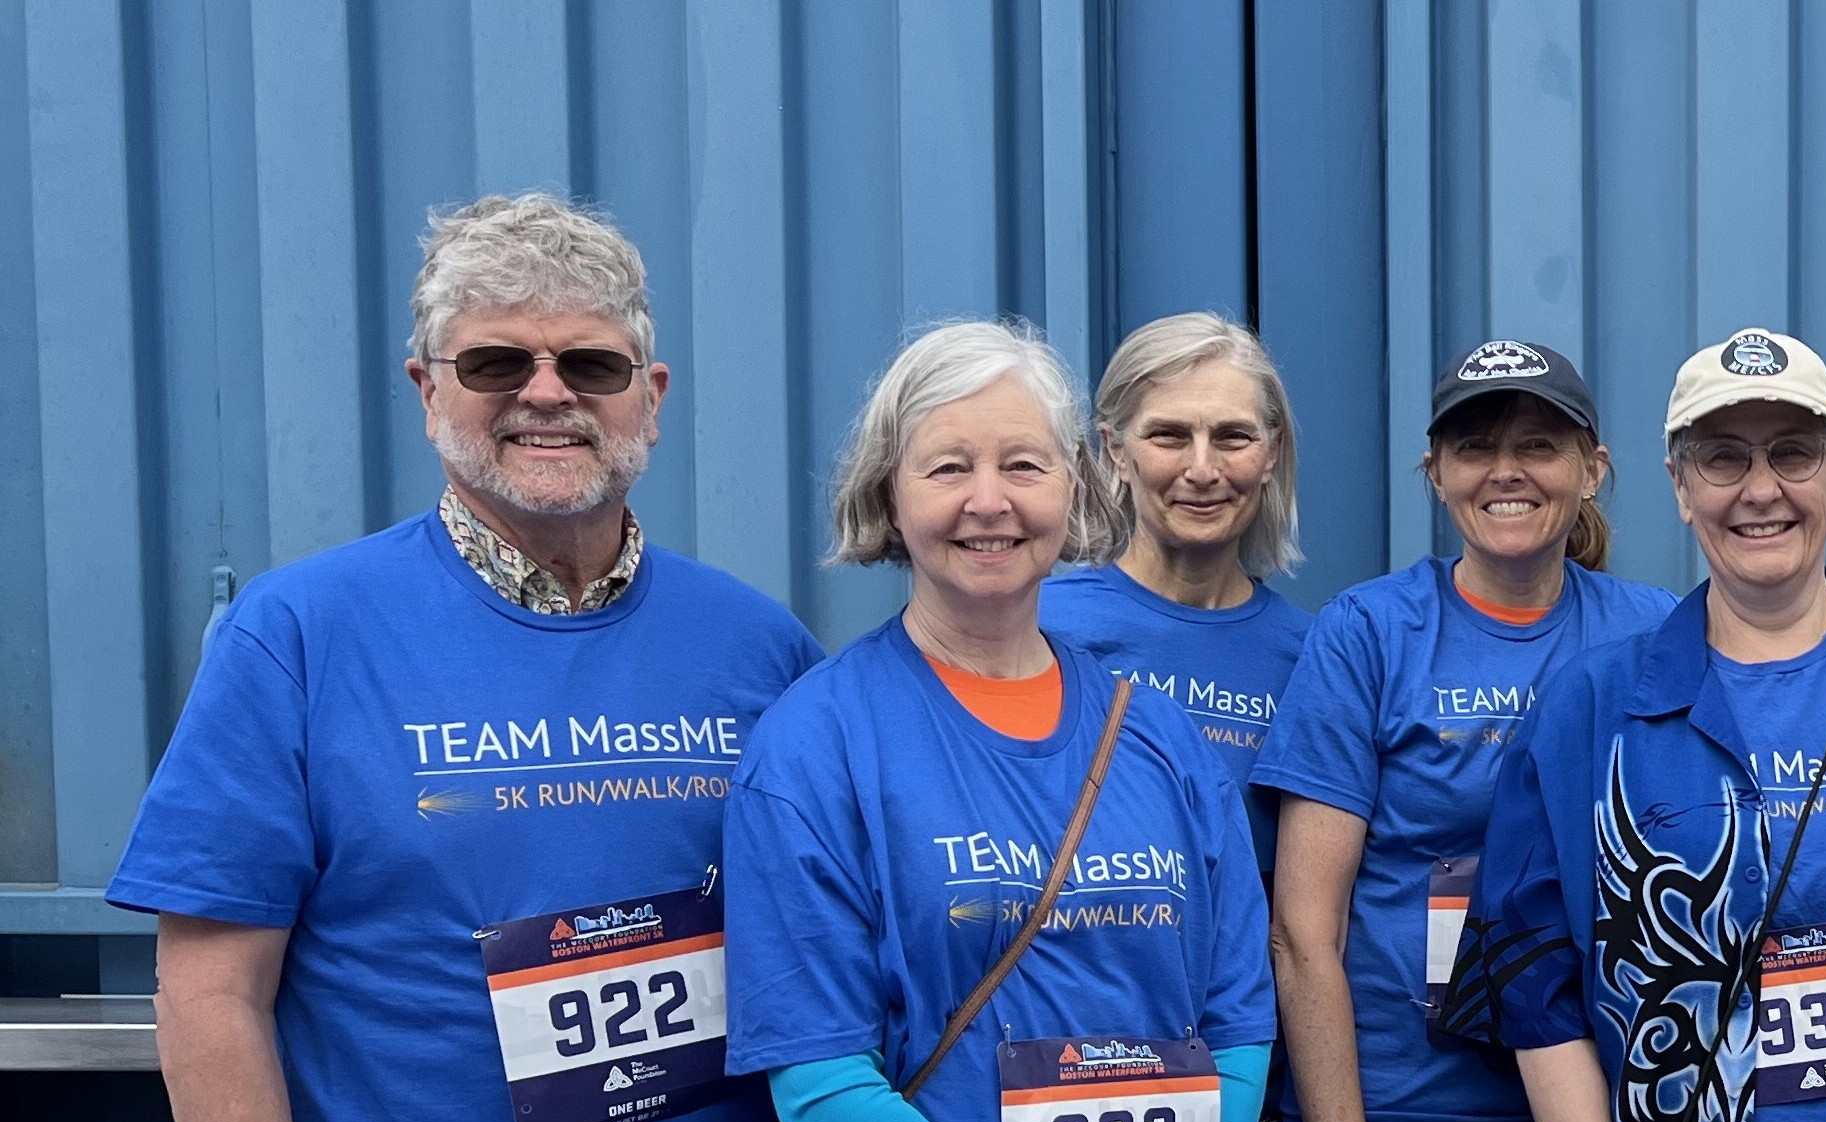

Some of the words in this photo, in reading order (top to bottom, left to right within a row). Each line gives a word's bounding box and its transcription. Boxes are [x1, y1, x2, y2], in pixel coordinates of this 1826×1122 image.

[1433, 686, 1519, 714] TEAM
[403, 719, 550, 764] TEAM
[569, 715, 741, 756] MassME
[495, 786, 529, 811] 5K
[538, 776, 731, 808] RUN/WALK/RO
[933, 831, 1042, 879] TEAM
[549, 970, 695, 1057] 922
[608, 1101, 634, 1117] ONE
[636, 1094, 667, 1110] BEER
